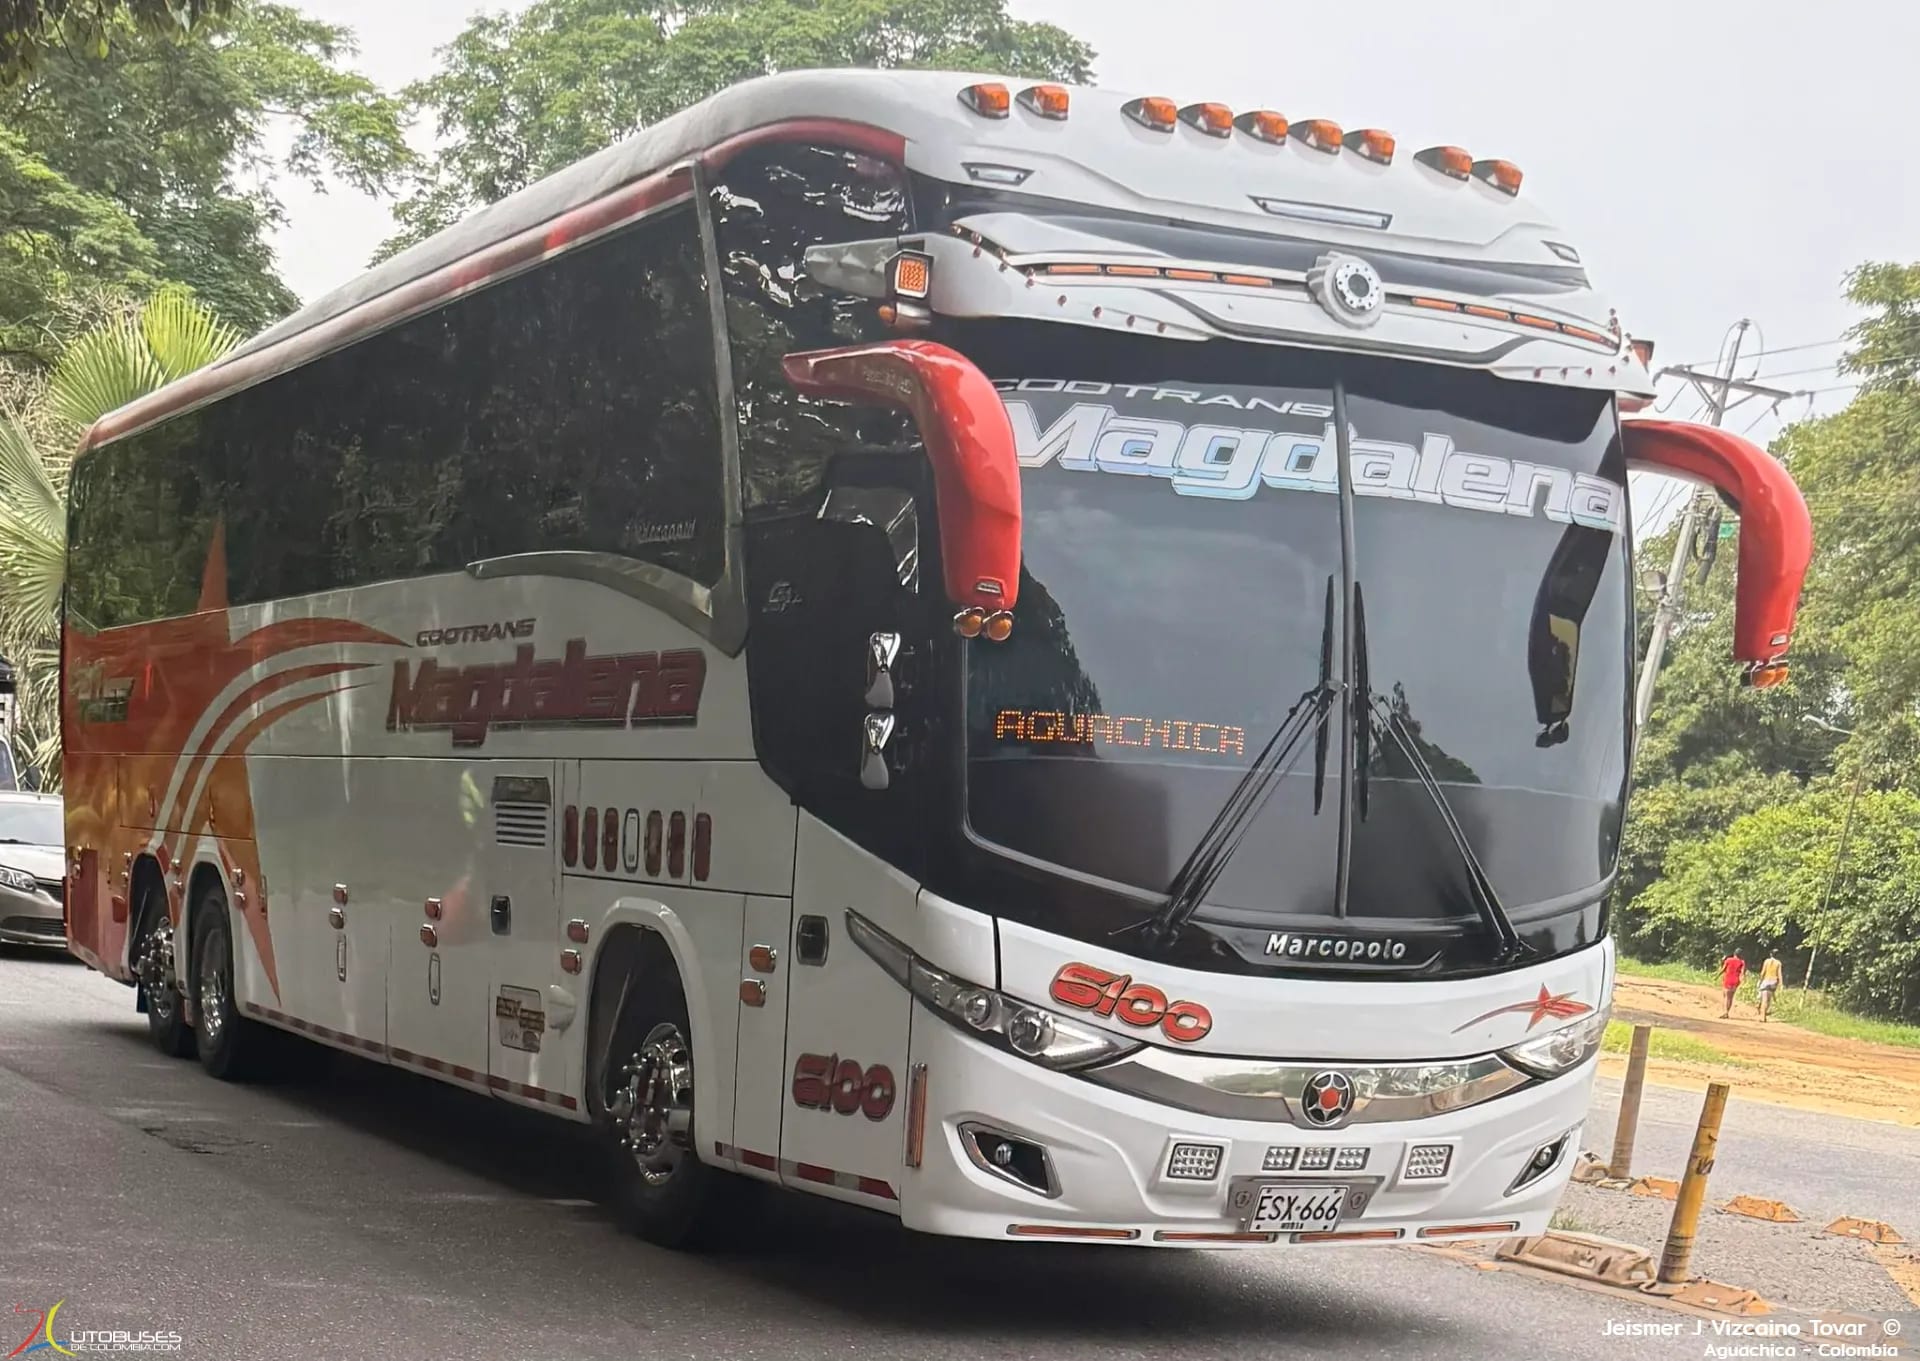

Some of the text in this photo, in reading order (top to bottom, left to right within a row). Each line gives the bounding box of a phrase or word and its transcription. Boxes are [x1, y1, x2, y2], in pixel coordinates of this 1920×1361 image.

[994, 377, 1334, 418] COOTRANS
[1006, 399, 1626, 530] Magdalena
[416, 617, 537, 648] COOTRANS
[386, 637, 708, 748] Magdalena
[996, 708, 1246, 754] AGUACHICA
[1263, 931, 1409, 961] Marcopolo
